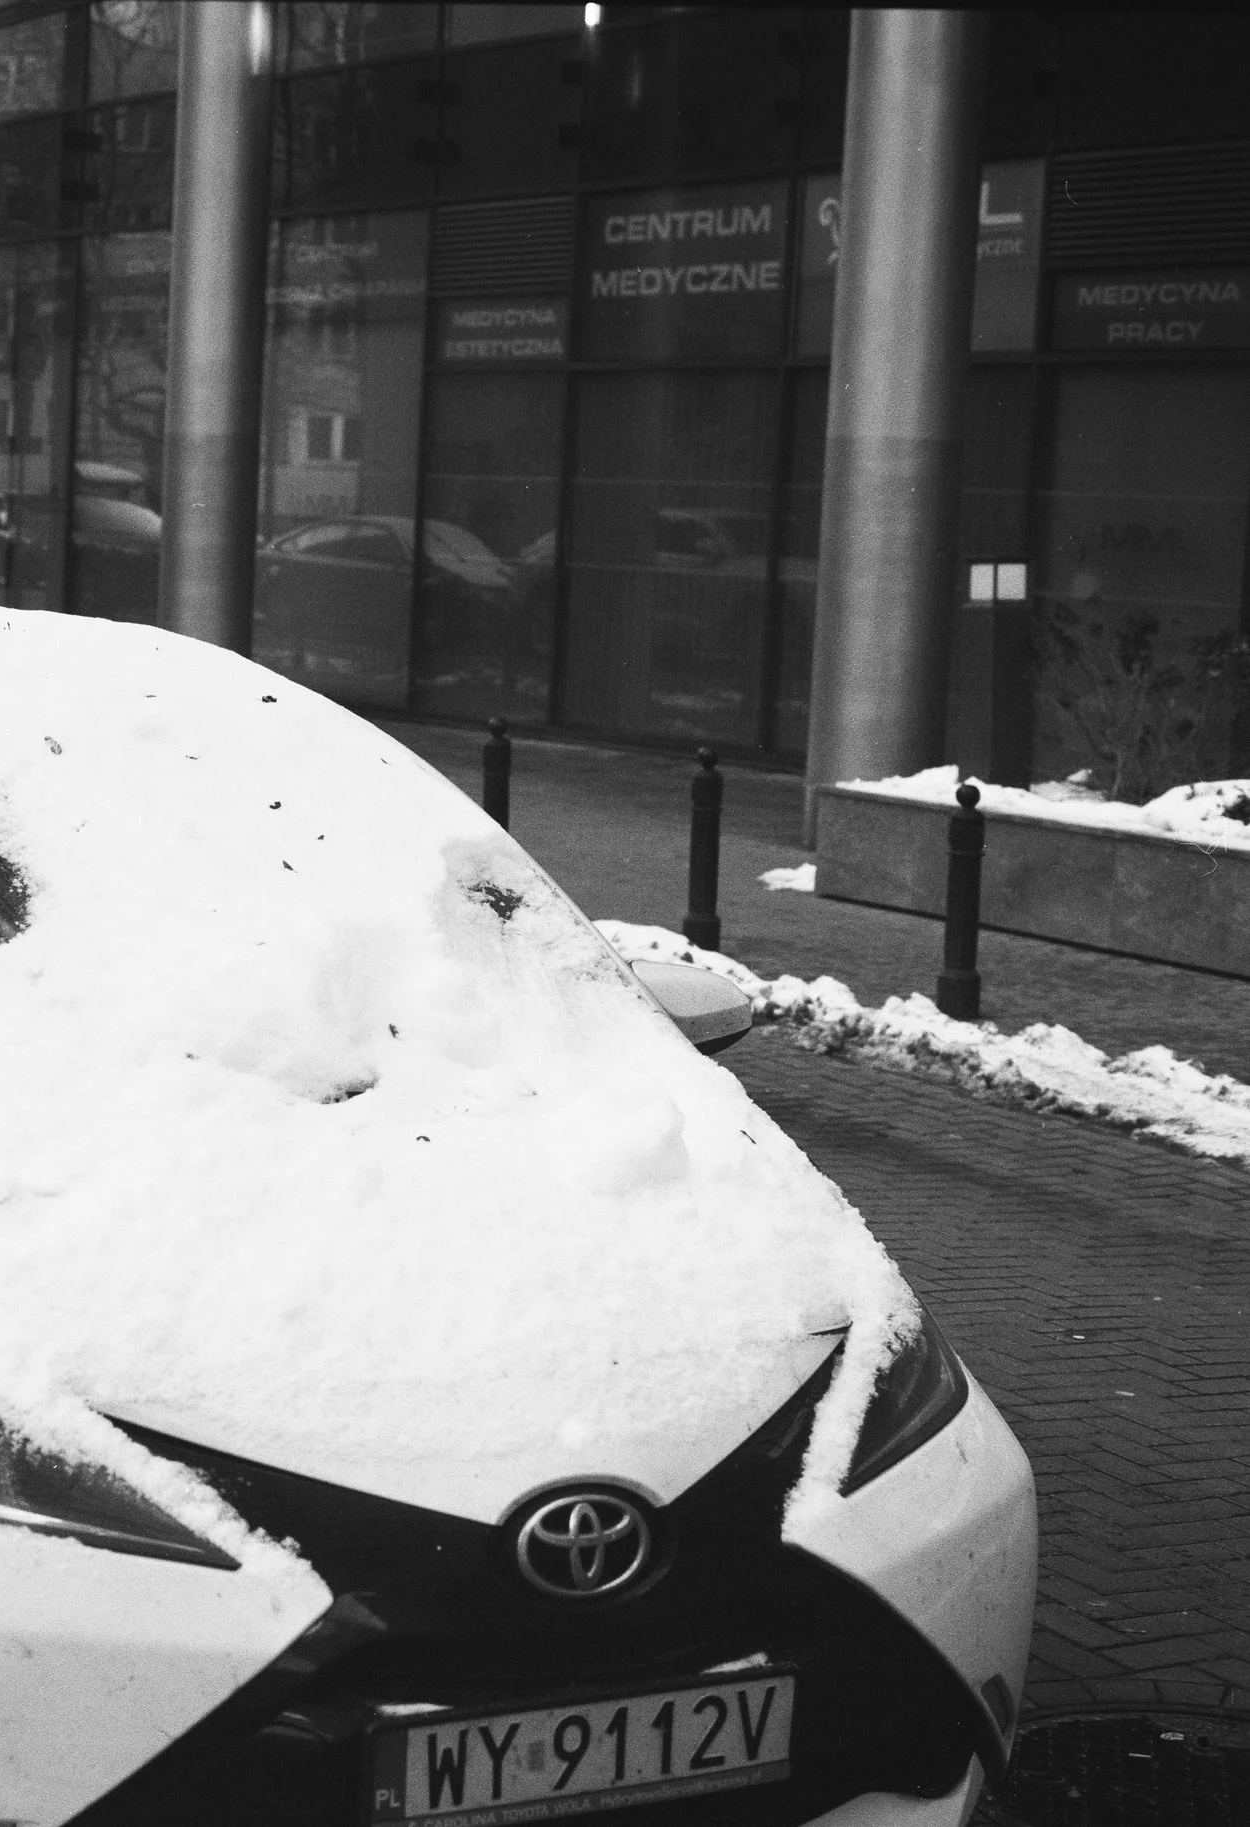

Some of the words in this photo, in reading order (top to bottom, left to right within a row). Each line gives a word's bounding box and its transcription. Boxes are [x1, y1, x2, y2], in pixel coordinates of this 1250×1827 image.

[604, 204, 773, 244] CENTRUM
[591, 260, 782, 299] MEDYCZNE
[1078, 282, 1240, 305] MEDYCYNA
[451, 307, 557, 328] MEDYCYNA
[1107, 319, 1205, 343] PRACY
[444, 336, 564, 359] ESTETYCZNA
[427, 1722, 521, 1809] WY
[552, 1685, 776, 1791] 9112V
[375, 1789, 400, 1811] PL
[502, 1804, 549, 1822] TOYOTA
[554, 1798, 591, 1815] WOLA
